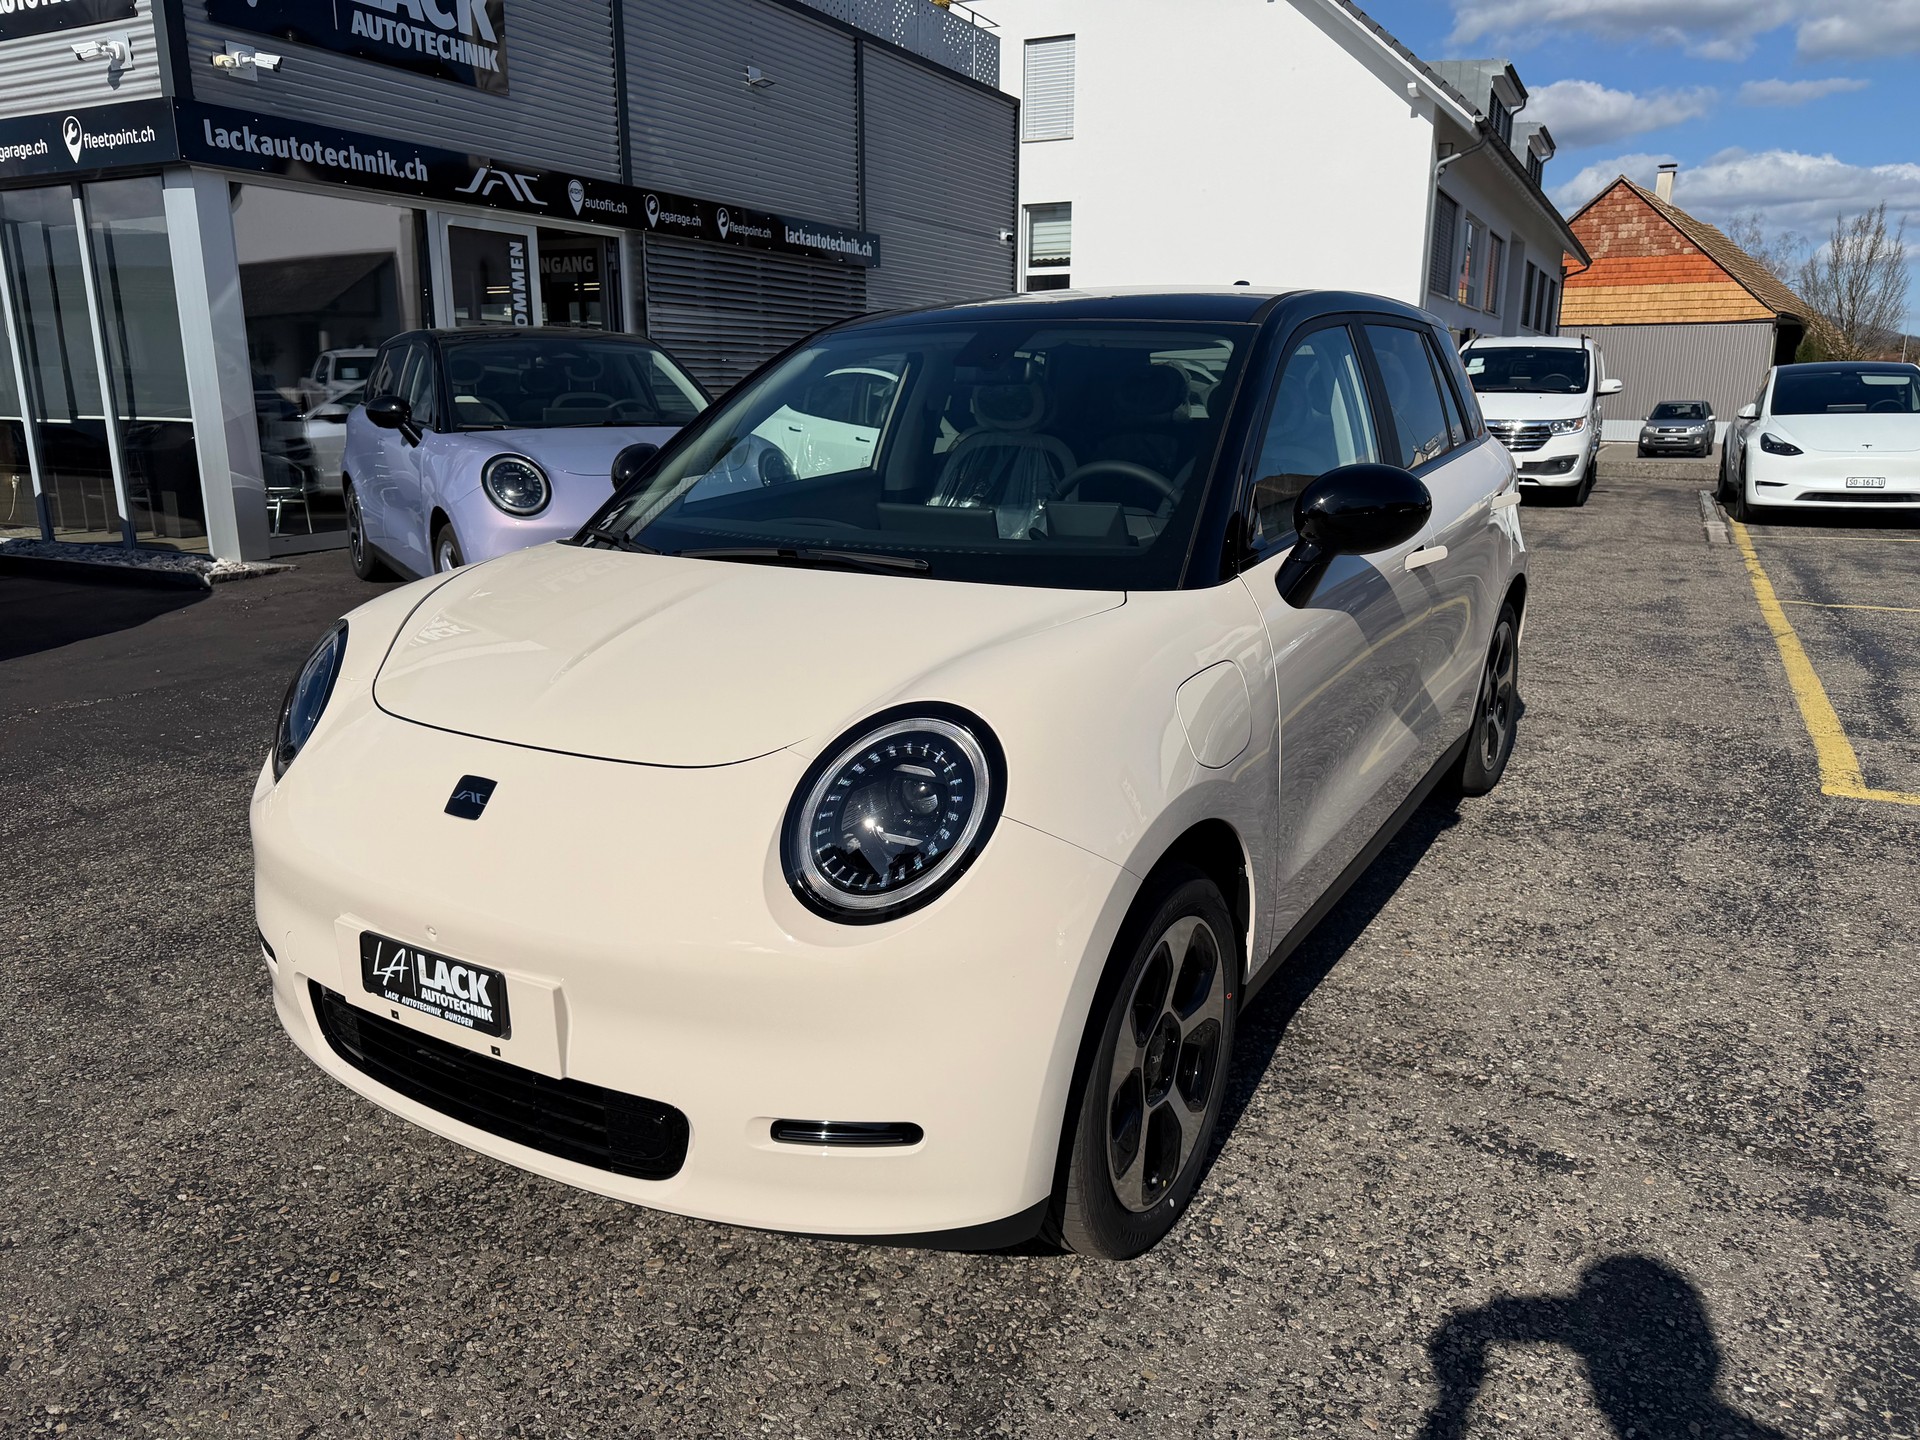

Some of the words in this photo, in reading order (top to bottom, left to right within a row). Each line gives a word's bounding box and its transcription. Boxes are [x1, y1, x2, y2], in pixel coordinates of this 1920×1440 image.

[351, 10, 500, 73] AUTOTECHNIK
[83, 126, 155, 149] fleetpoint.ch
[203, 119, 428, 182] lackautotechnik.ch
[585, 198, 628, 214] autofit.ch
[659, 210, 701, 228] egarage.ch
[729, 221, 771, 239] fleetpoint.ch
[785, 225, 872, 257] lackautotechnik.ch
[373, 941, 409, 986] LA
[417, 953, 493, 1007] LACK
[384, 989, 400, 1003] LACK
[401, 996, 442, 1017] AUTOTECHNIK
[444, 1011, 474, 1028] GUNZGEN
[421, 987, 494, 1023] AUTOTECHNIK
